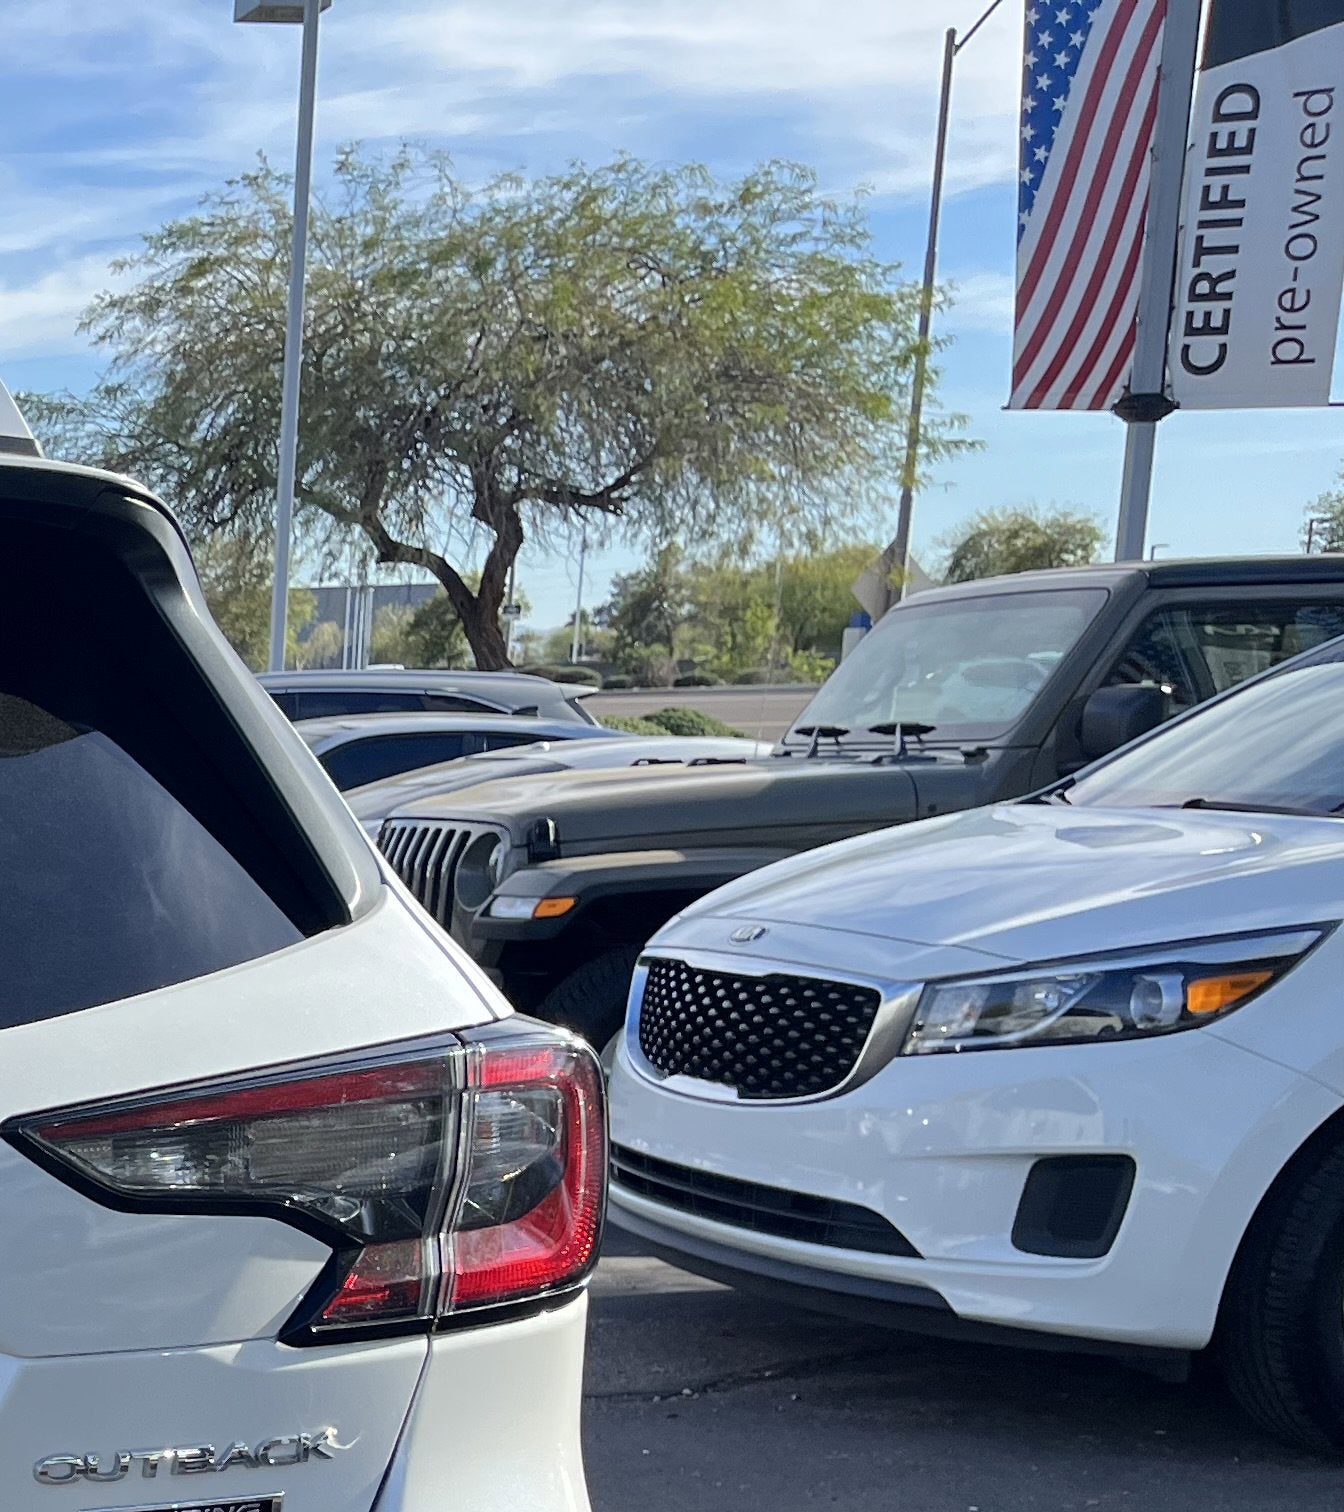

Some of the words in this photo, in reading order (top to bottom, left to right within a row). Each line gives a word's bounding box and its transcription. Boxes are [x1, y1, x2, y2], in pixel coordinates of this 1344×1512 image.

[1180, 82, 1262, 376] CERTIFIED
[1269, 86, 1336, 367] pre-owned
[33, 1427, 359, 1485] OUTBACK
